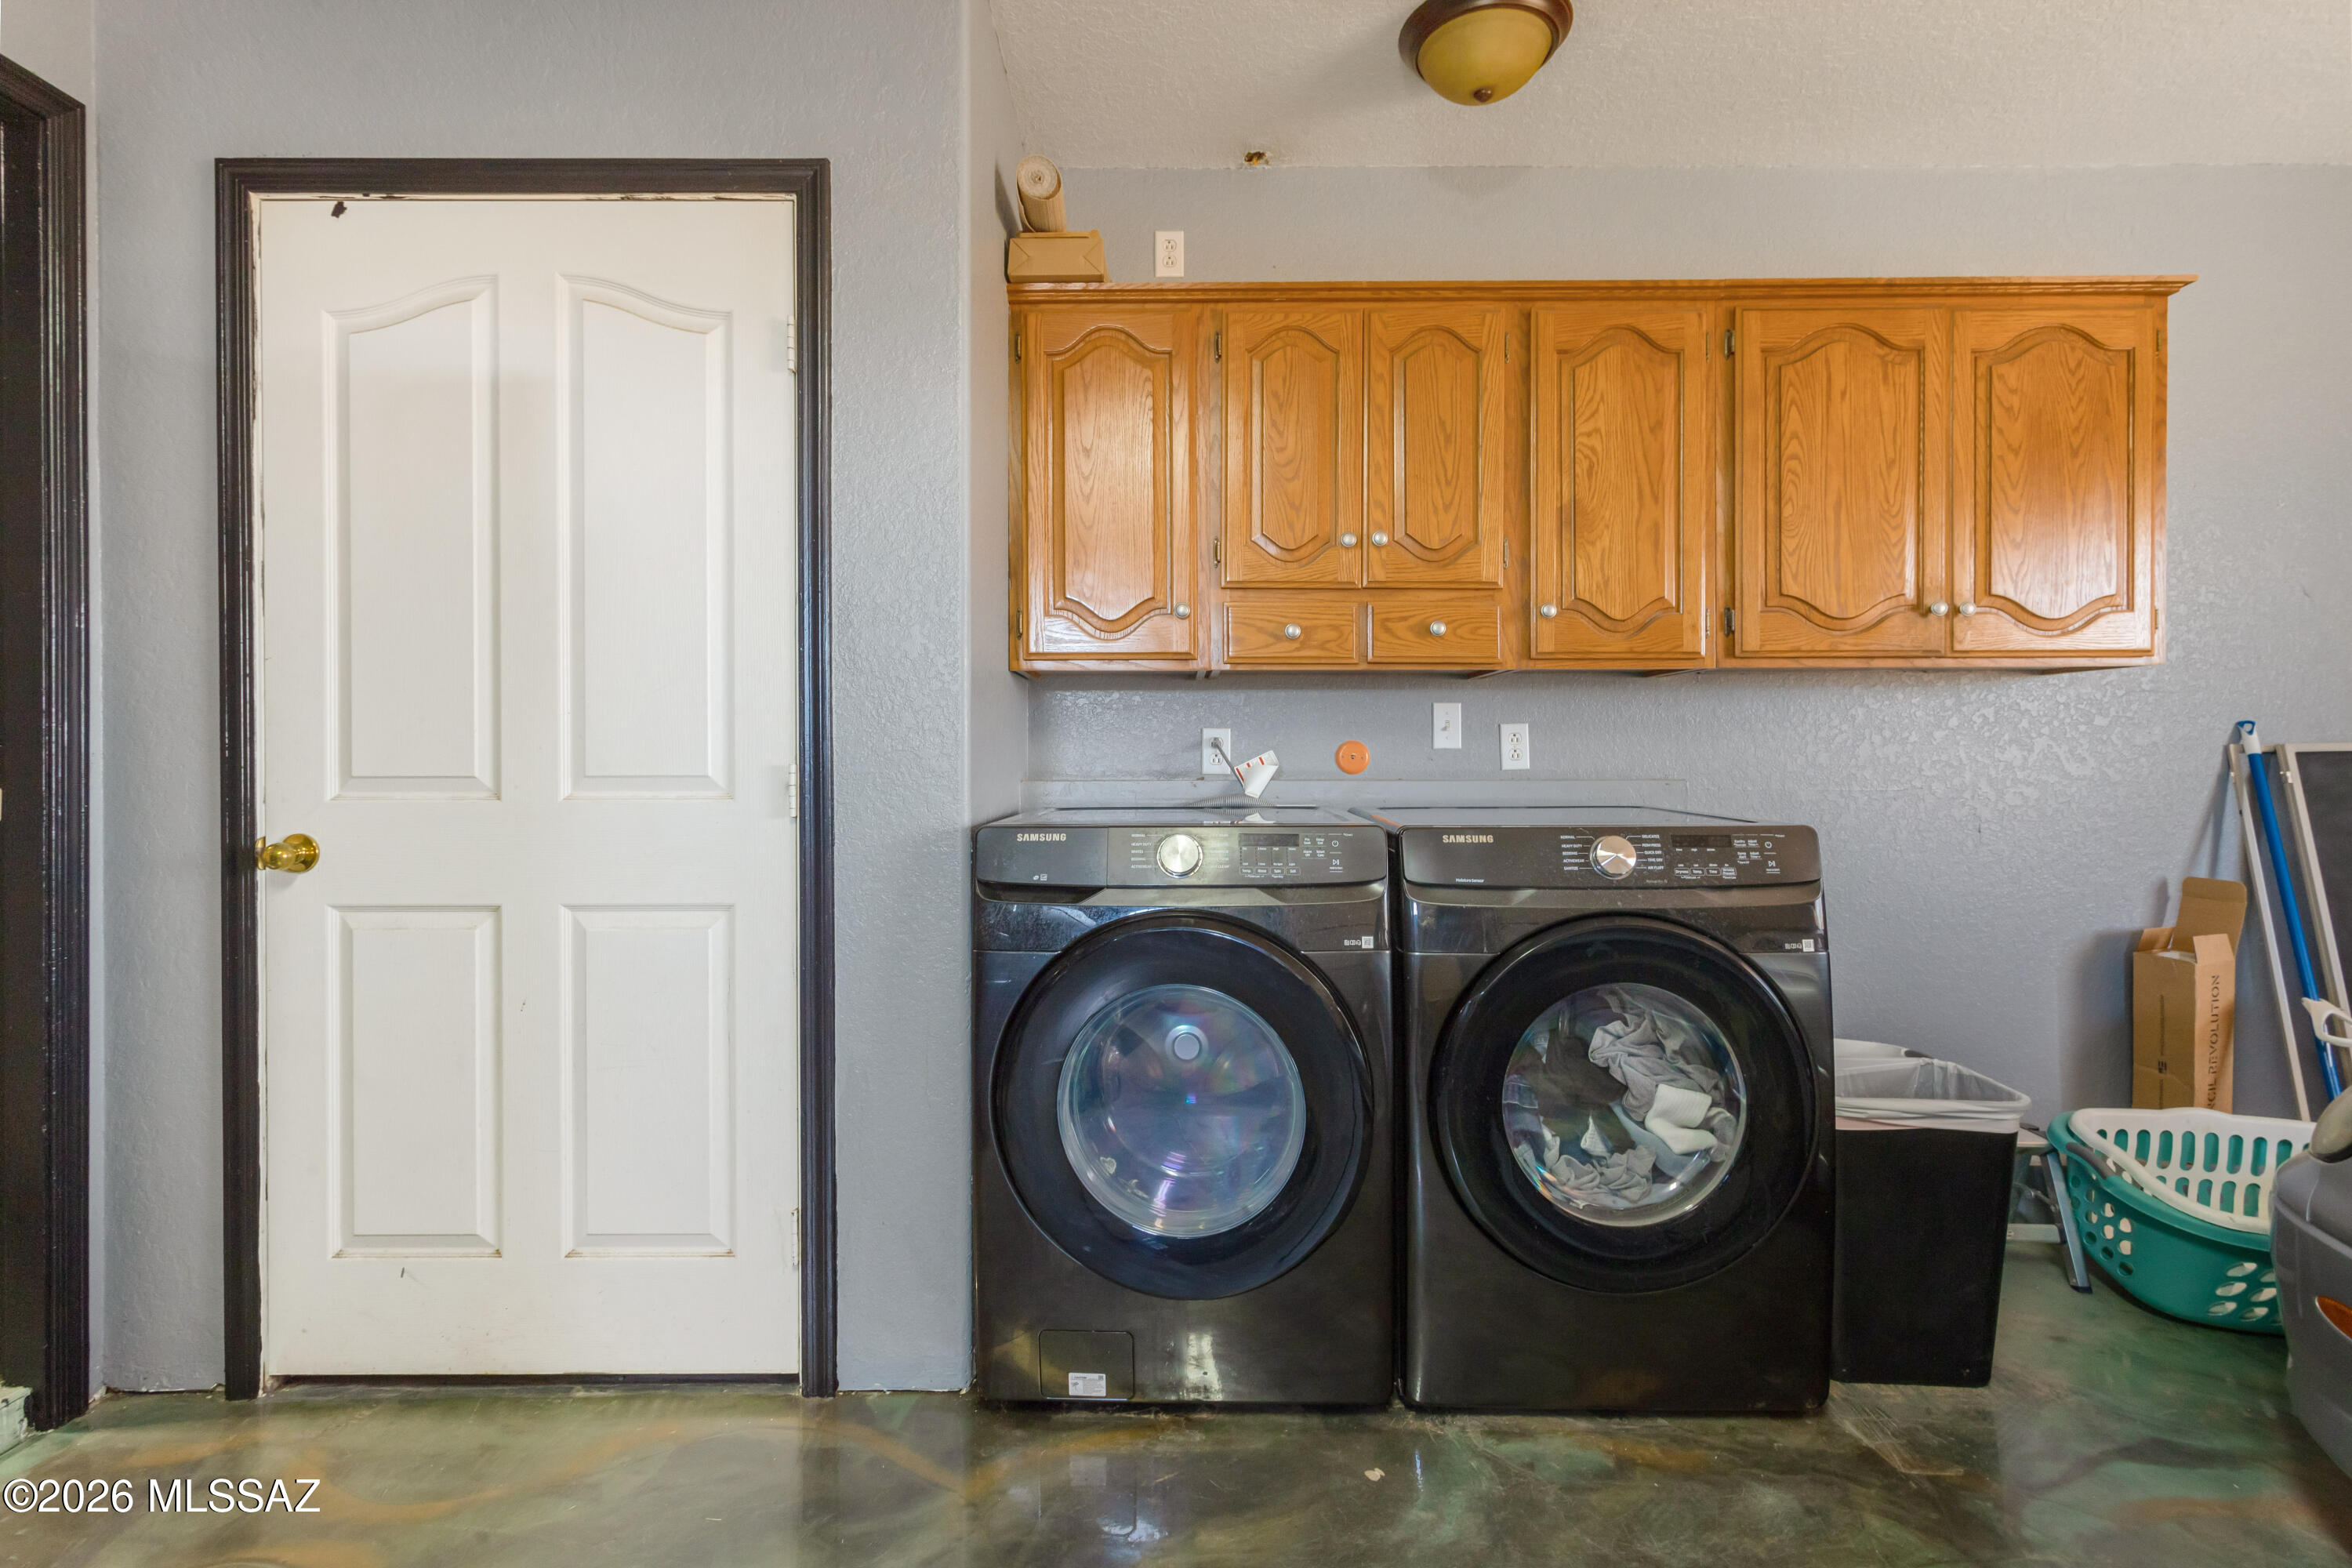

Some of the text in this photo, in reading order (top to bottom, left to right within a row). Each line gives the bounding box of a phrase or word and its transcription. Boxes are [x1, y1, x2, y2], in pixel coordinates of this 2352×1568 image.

[1016, 833, 1067, 842] SAMSUNG
[1442, 834, 1494, 844] SAMSUNG
[2209, 975, 2220, 1075] REVOLUTION
